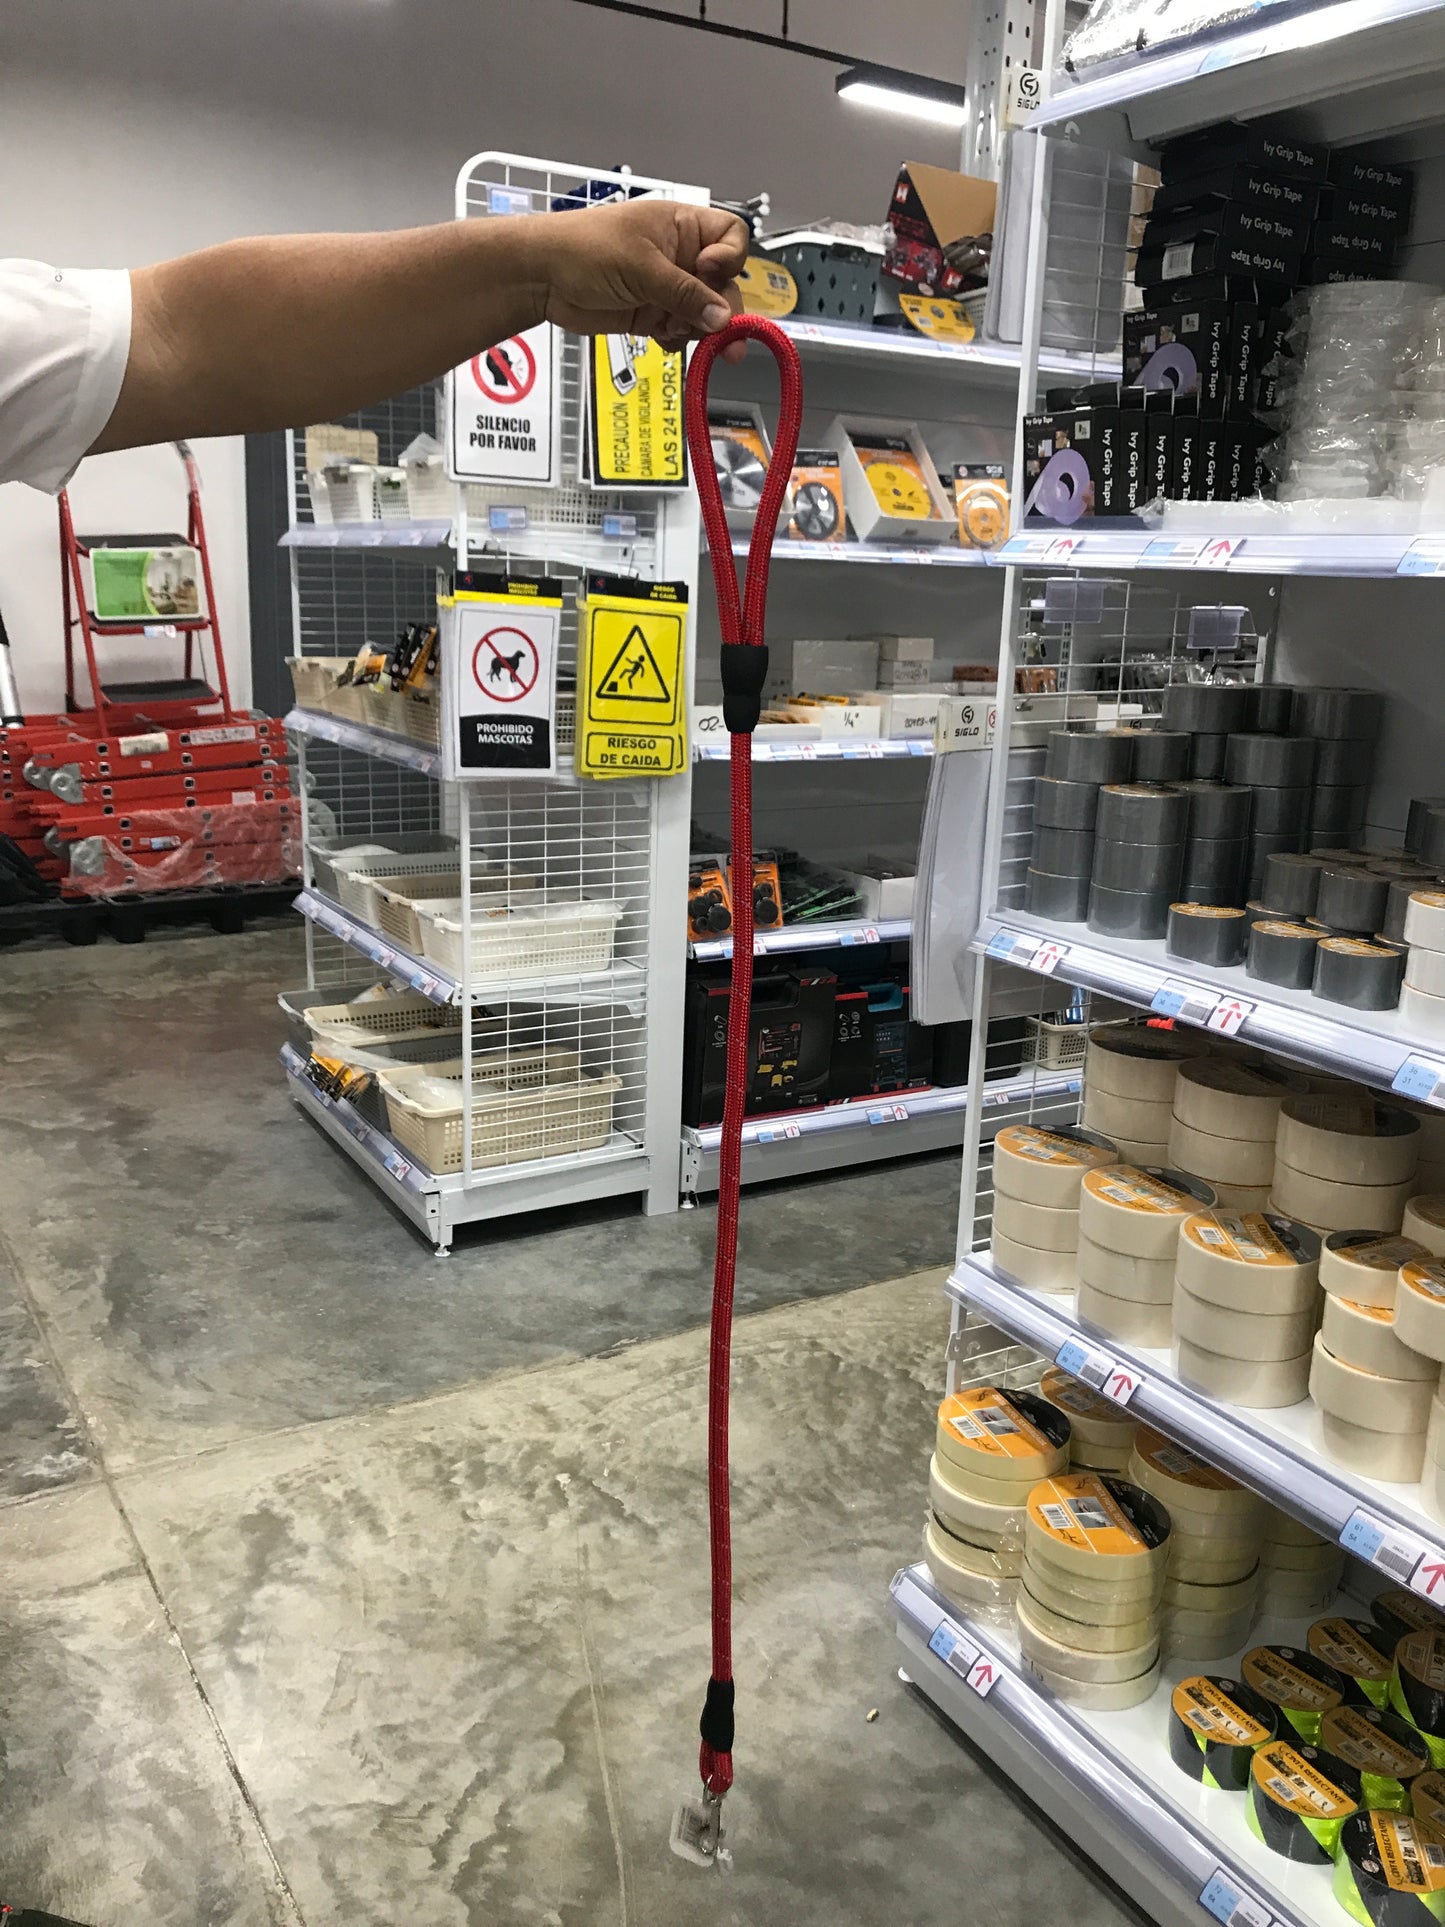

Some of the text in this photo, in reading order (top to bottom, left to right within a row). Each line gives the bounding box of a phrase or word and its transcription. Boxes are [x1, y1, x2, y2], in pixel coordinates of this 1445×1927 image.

[1264, 140, 1314, 166] Ivy Grip Tape
[1354, 164, 1402, 185] Ivy Grip Tape
[1248, 178, 1302, 202] Ivy Grip Tape
[1348, 201, 1398, 220] Ivy Grip Tape
[1240, 214, 1293, 238] Ivy Grip Tape
[1332, 234, 1382, 252] Ivy Grip Tape
[1231, 250, 1285, 272] Ivy Grip Tape
[1210, 322, 1220, 398] Ivy Grip Tape
[1238, 325, 1250, 401] Ivy Grip Tape
[638, 377, 650, 426] VIGILANCIA
[476, 414, 530, 432] SILENCIO
[640, 427, 651, 438] DE
[663, 418, 677, 436] 24
[470, 432, 536, 452] POR FAVOR
[1232, 444, 1242, 460] Ivy
[664, 442, 678, 476] LAS
[1102, 428, 1112, 506] Ivy Grip Tape
[1128, 432, 1138, 508] Ivy Grip Tape
[1156, 435, 1166, 497] Ivy Grip Ta
[1181, 438, 1192, 500] Ivy Grip Ta
[1206, 442, 1216, 500] Ivy Grip Ta
[1230, 463, 1240, 488] Grip
[476, 723, 534, 735] PROHIBIDO
[478, 734, 534, 745] MASCOTAS
[954, 727, 980, 736] SIGLO
[608, 737, 656, 750] RIESGO
[600, 754, 662, 766] DE CAIDA
[1204, 1685, 1222, 1701] CINTA
[1221, 1700, 1260, 1733] REFLECTANTE
[1285, 1752, 1305, 1770] CINTA
[1304, 1768, 1346, 1804] REFLECTANTE
[1388, 1860, 1400, 1878] CINTA
